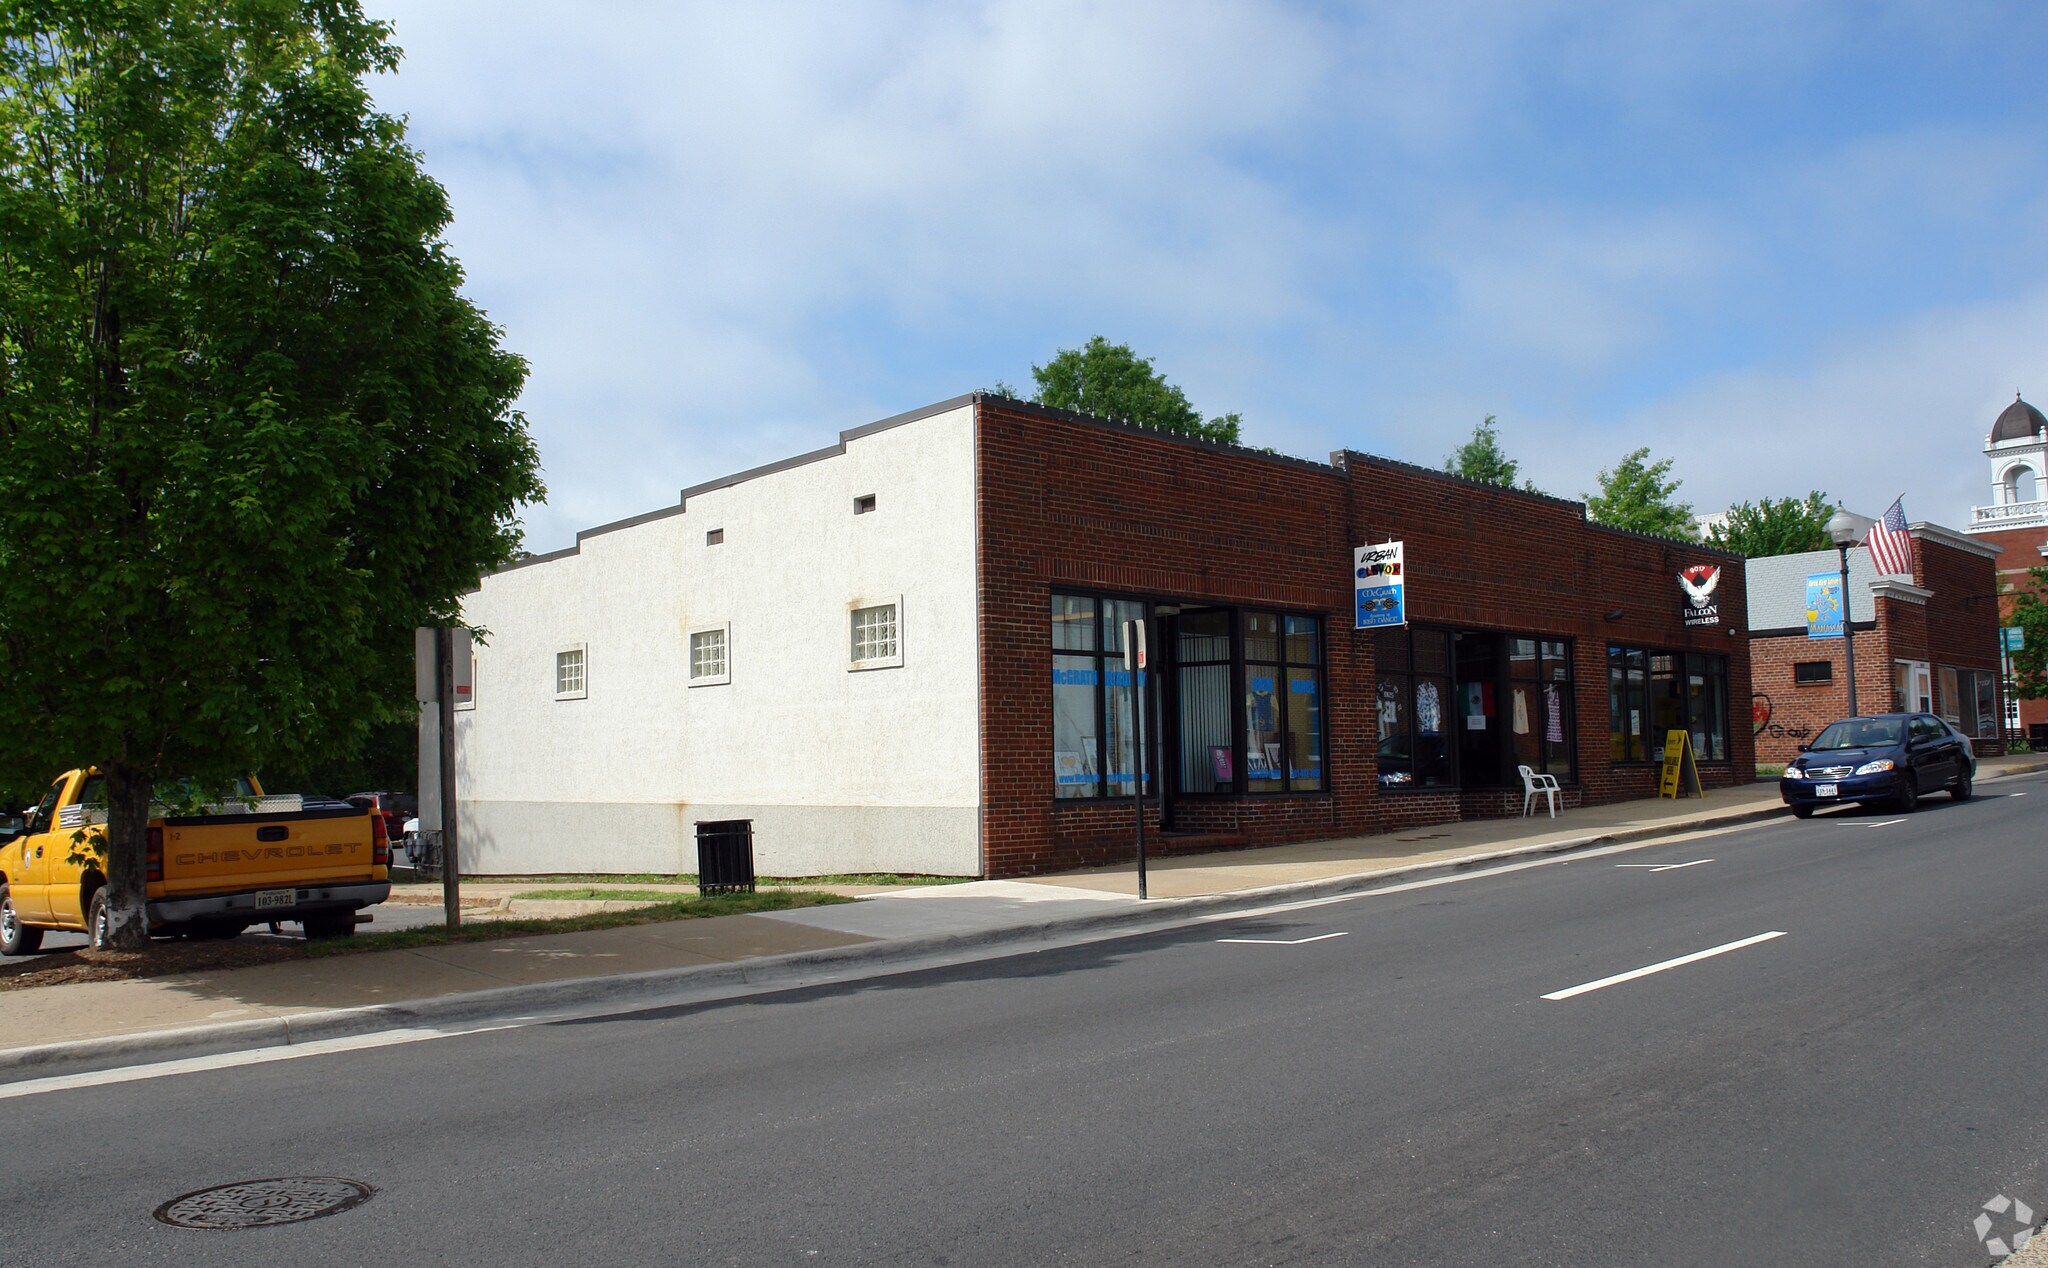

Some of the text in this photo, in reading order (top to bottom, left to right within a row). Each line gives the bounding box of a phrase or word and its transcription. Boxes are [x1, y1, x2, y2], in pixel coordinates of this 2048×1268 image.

[1361, 547, 1398, 563] URBAN
[1356, 563, 1401, 578] FLAVOR
[1684, 605, 1717, 617] FALCON
[1685, 616, 1720, 626] WIRELESS
[176, 842, 362, 865] CHEVROLET
